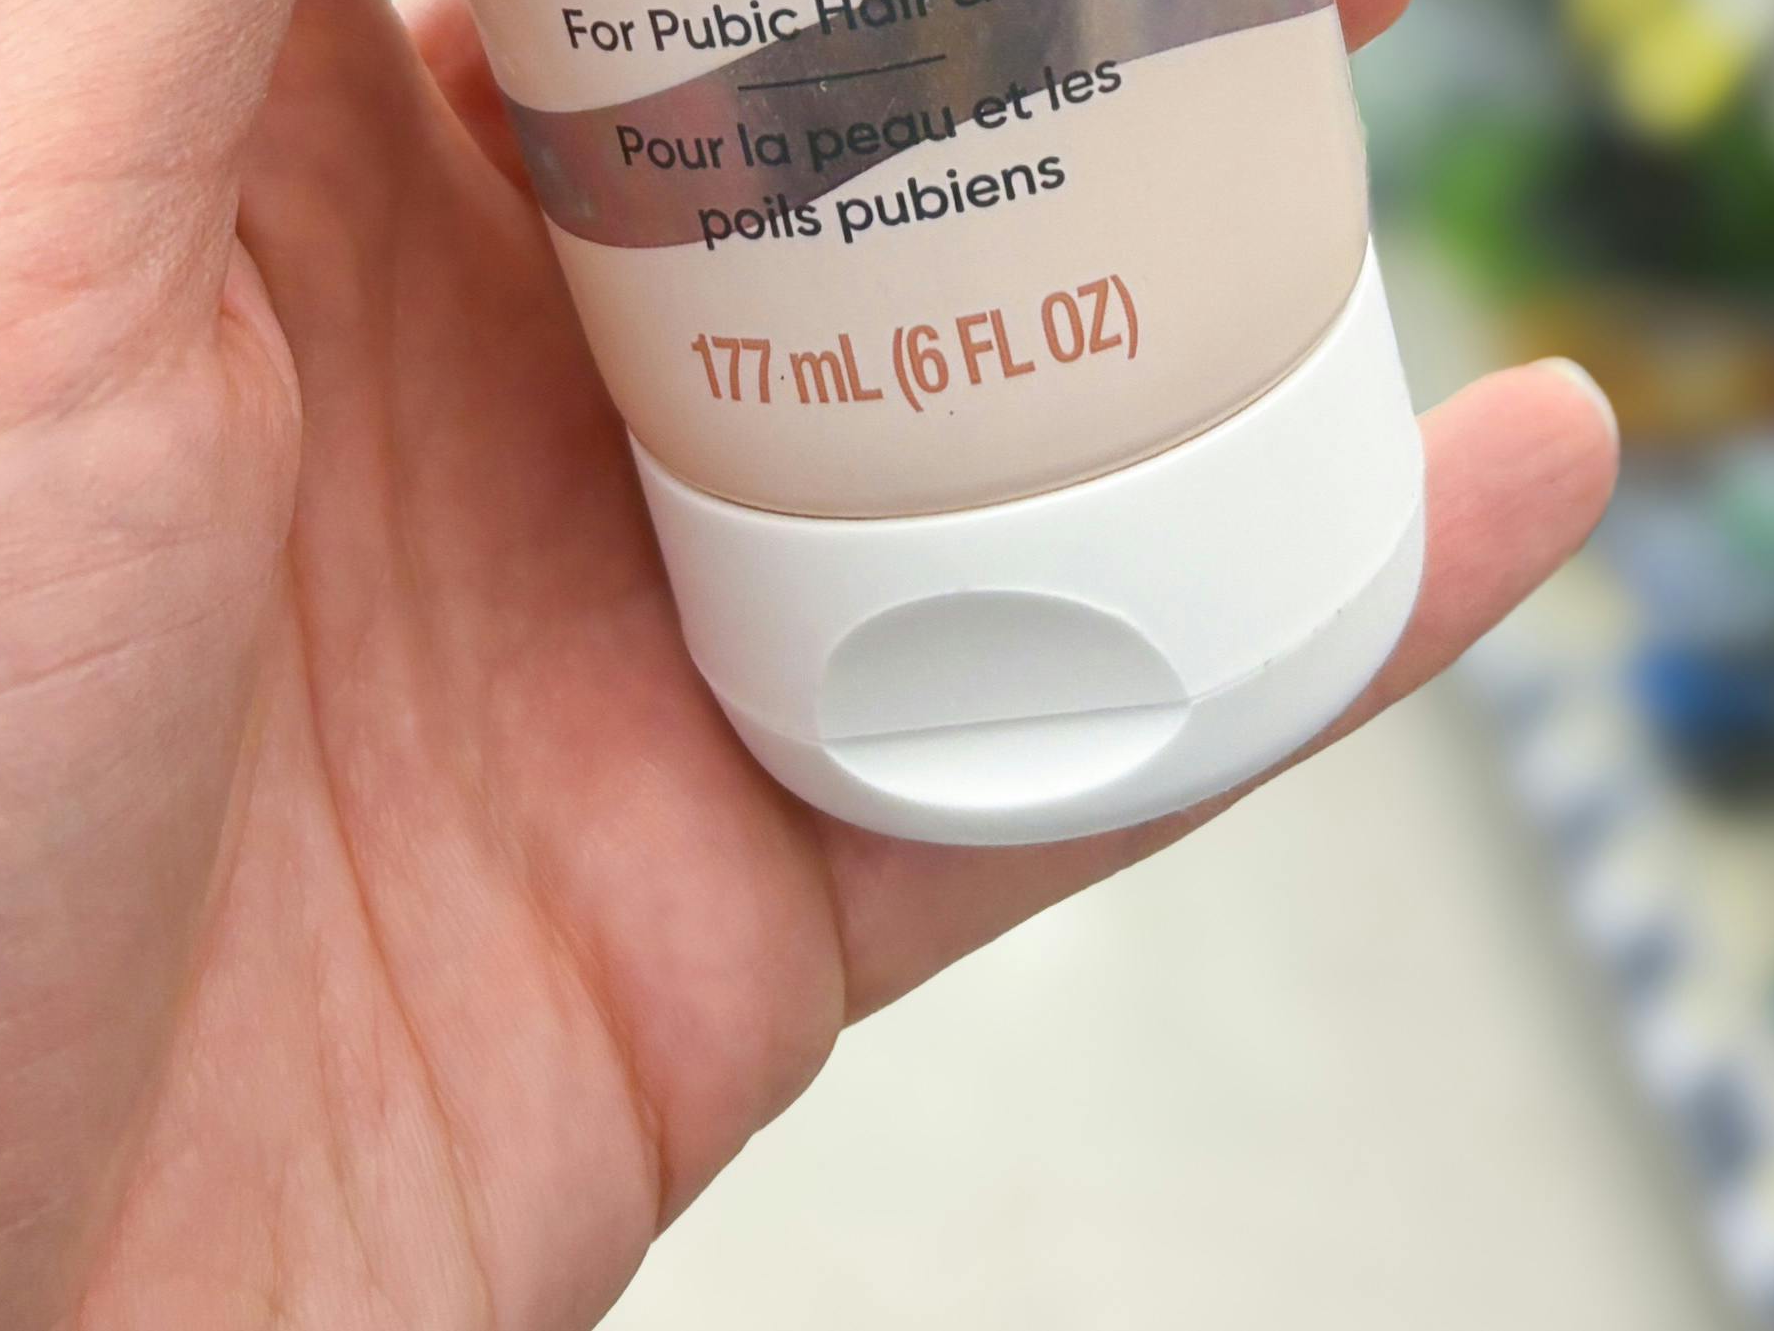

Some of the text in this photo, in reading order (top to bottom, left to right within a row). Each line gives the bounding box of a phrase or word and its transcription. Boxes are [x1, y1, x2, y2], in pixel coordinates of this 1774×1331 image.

[561, 7, 636, 52] For
[616, 57, 1123, 172] Pour la peau et les
[698, 155, 1066, 250] poils pubiens
[690, 272, 1139, 412] 177 mL (6 FL OZ)
